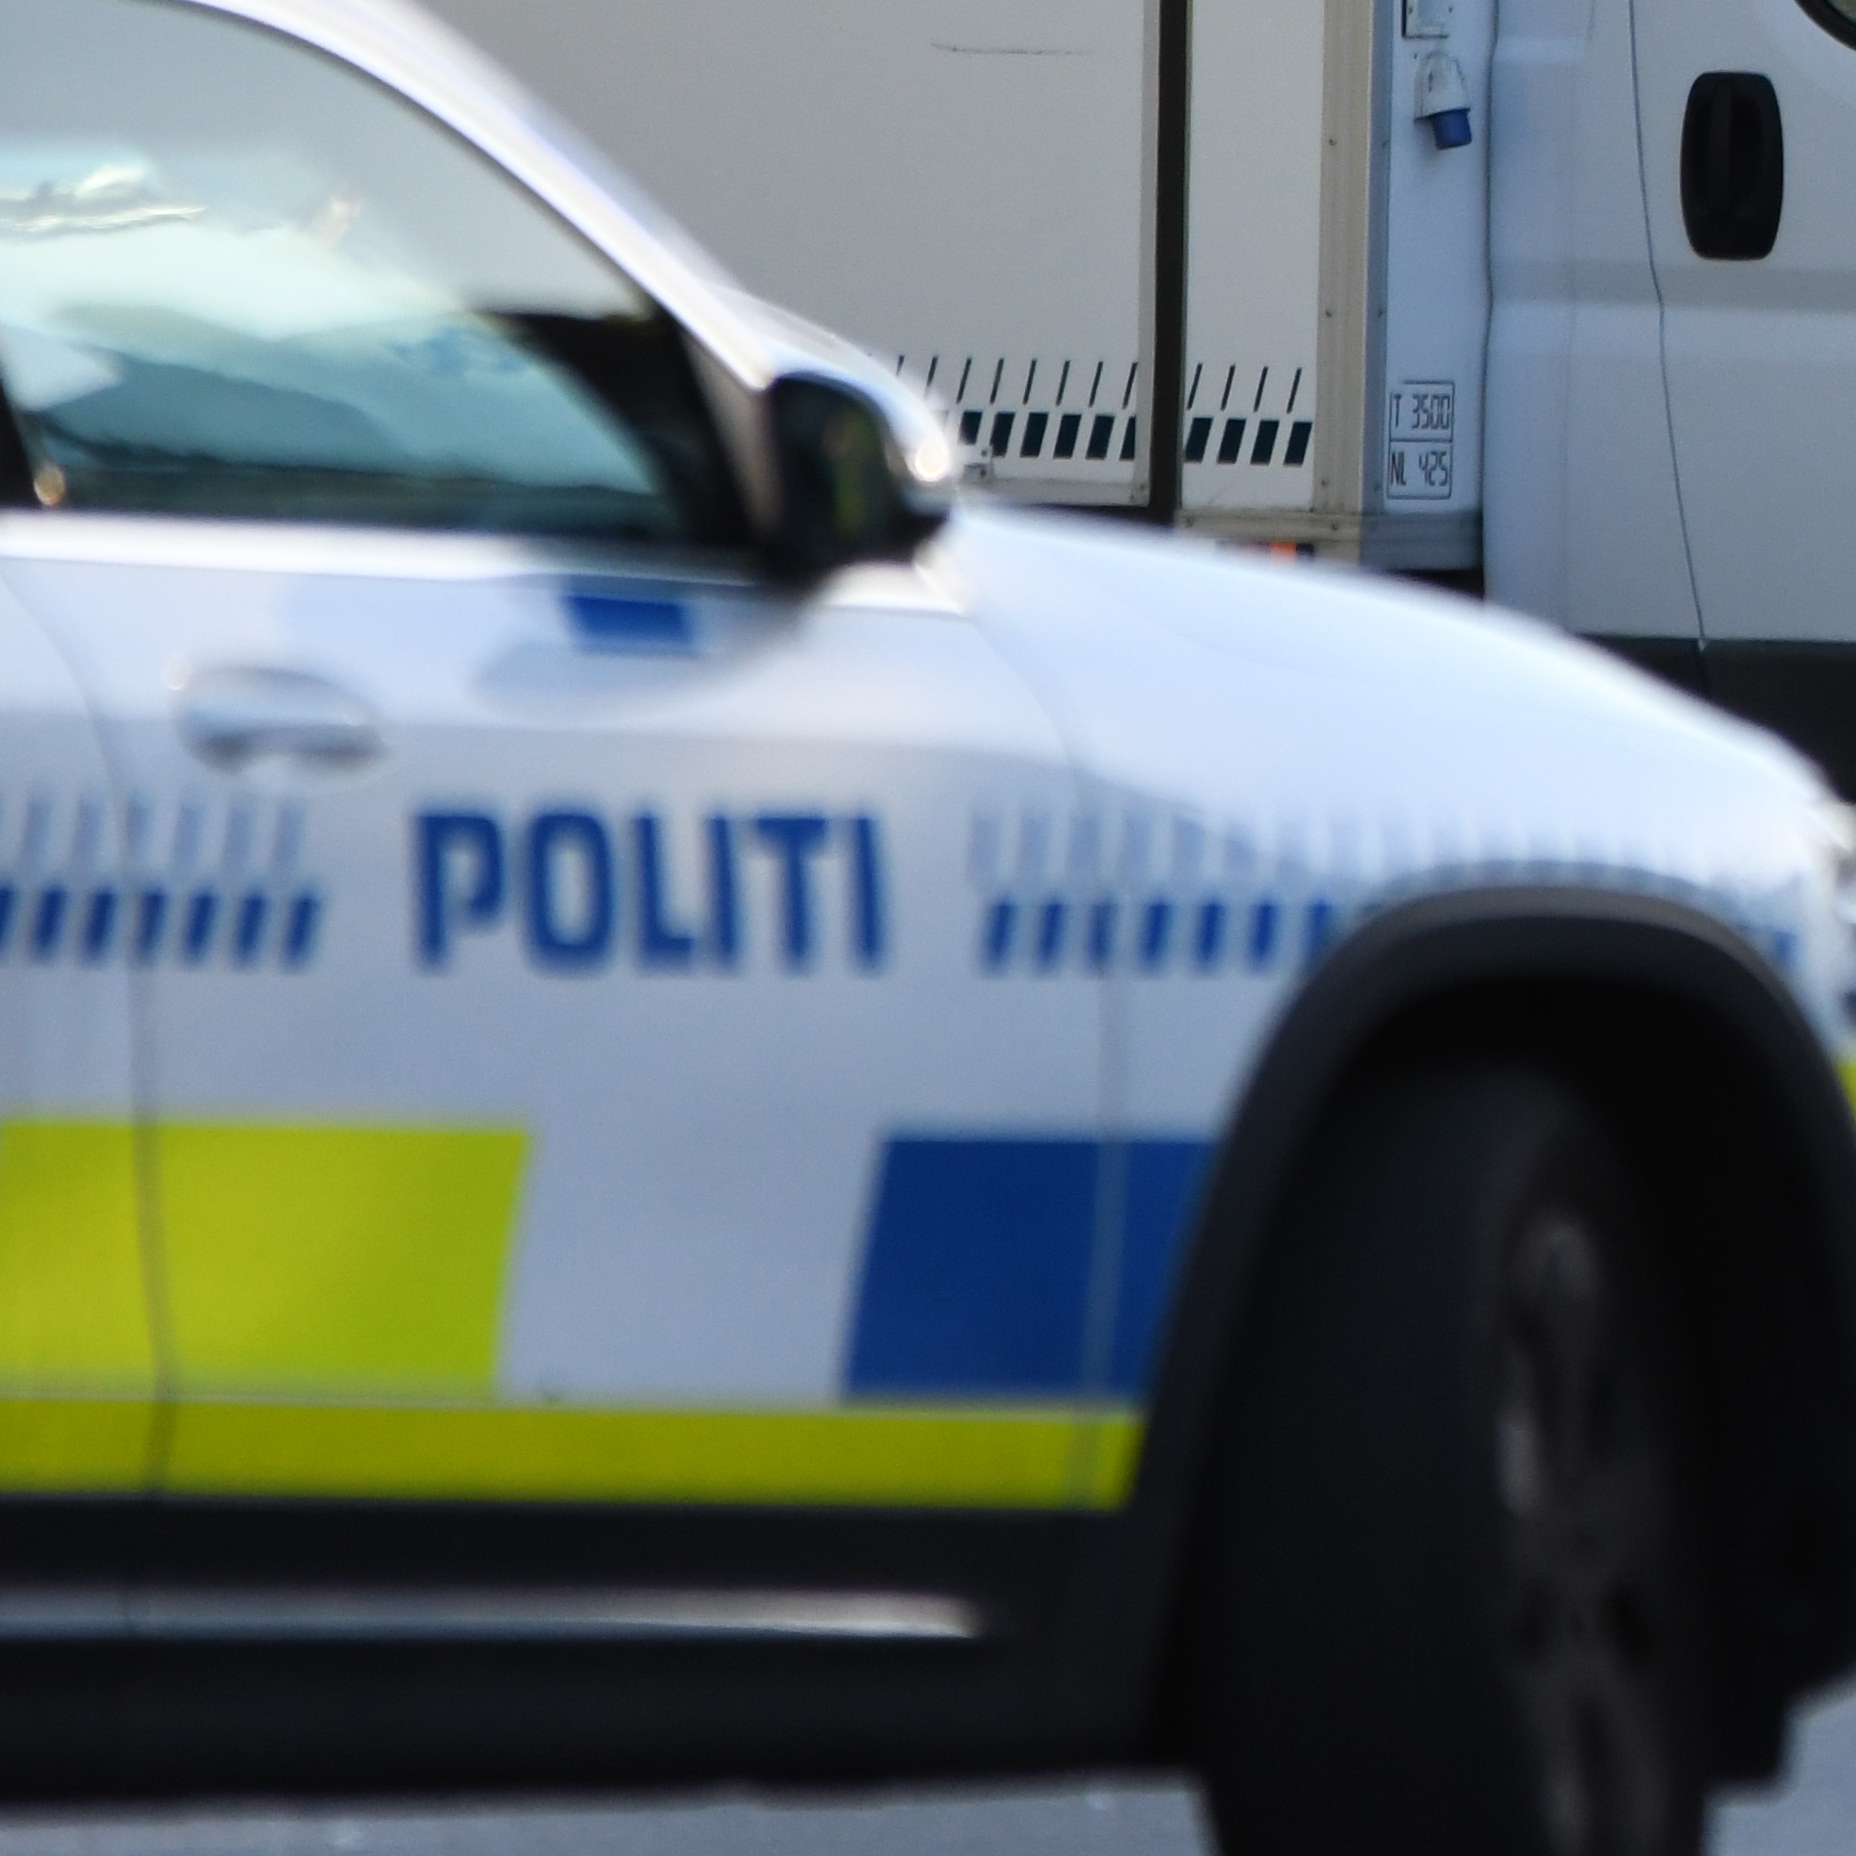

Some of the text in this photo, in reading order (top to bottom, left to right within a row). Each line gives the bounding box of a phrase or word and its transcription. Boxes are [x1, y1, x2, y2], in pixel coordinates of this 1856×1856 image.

[1393, 394, 1450, 429] T 3500
[1390, 451, 1449, 486] NL 425
[414, 811, 884, 973] POLITI
